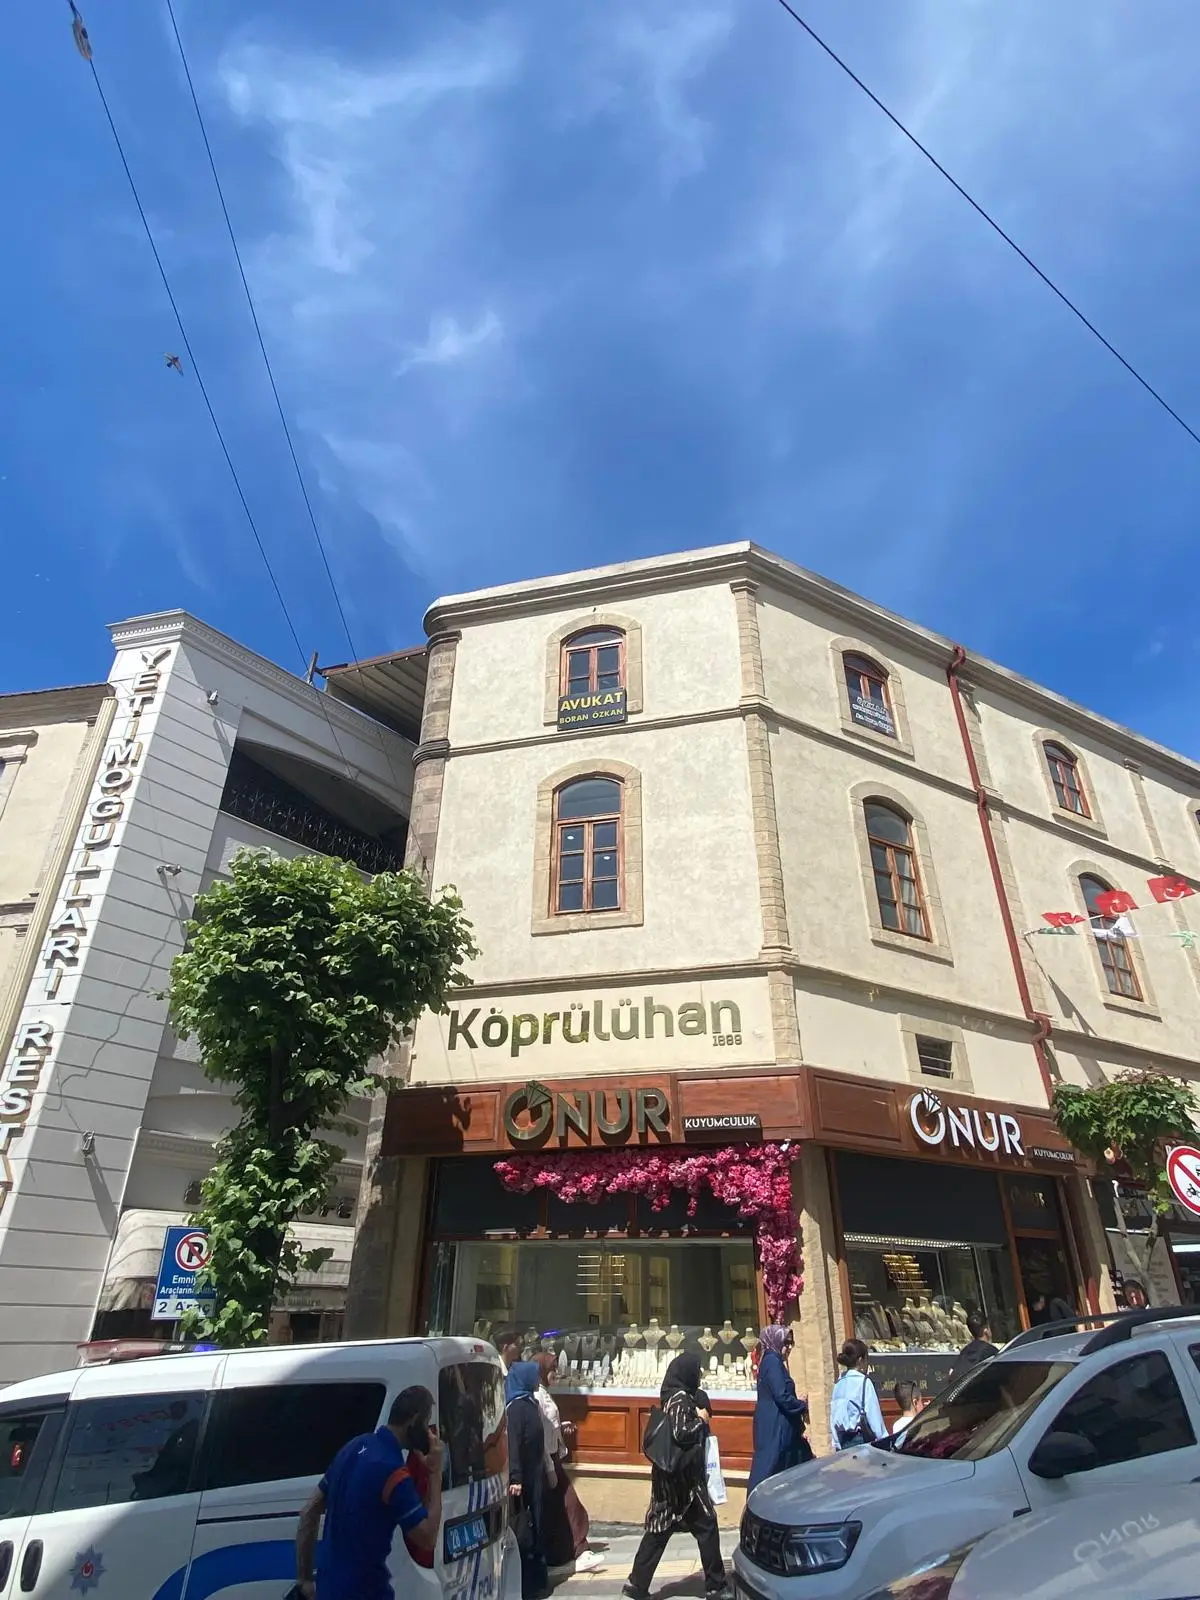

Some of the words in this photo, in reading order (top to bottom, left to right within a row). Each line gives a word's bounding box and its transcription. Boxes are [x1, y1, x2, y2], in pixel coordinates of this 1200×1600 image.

[560, 691, 623, 711] AVUKAT
[559, 714, 589, 724] BORAN
[592, 708, 623, 719] ÖZKAN
[447, 996, 742, 1057] Köprülühan
[503, 1080, 669, 1141] ONUR
[685, 1116, 757, 1128] KUYUMCULUK
[910, 1087, 1024, 1156] ONUR
[158, 1301, 168, 1313] 2
